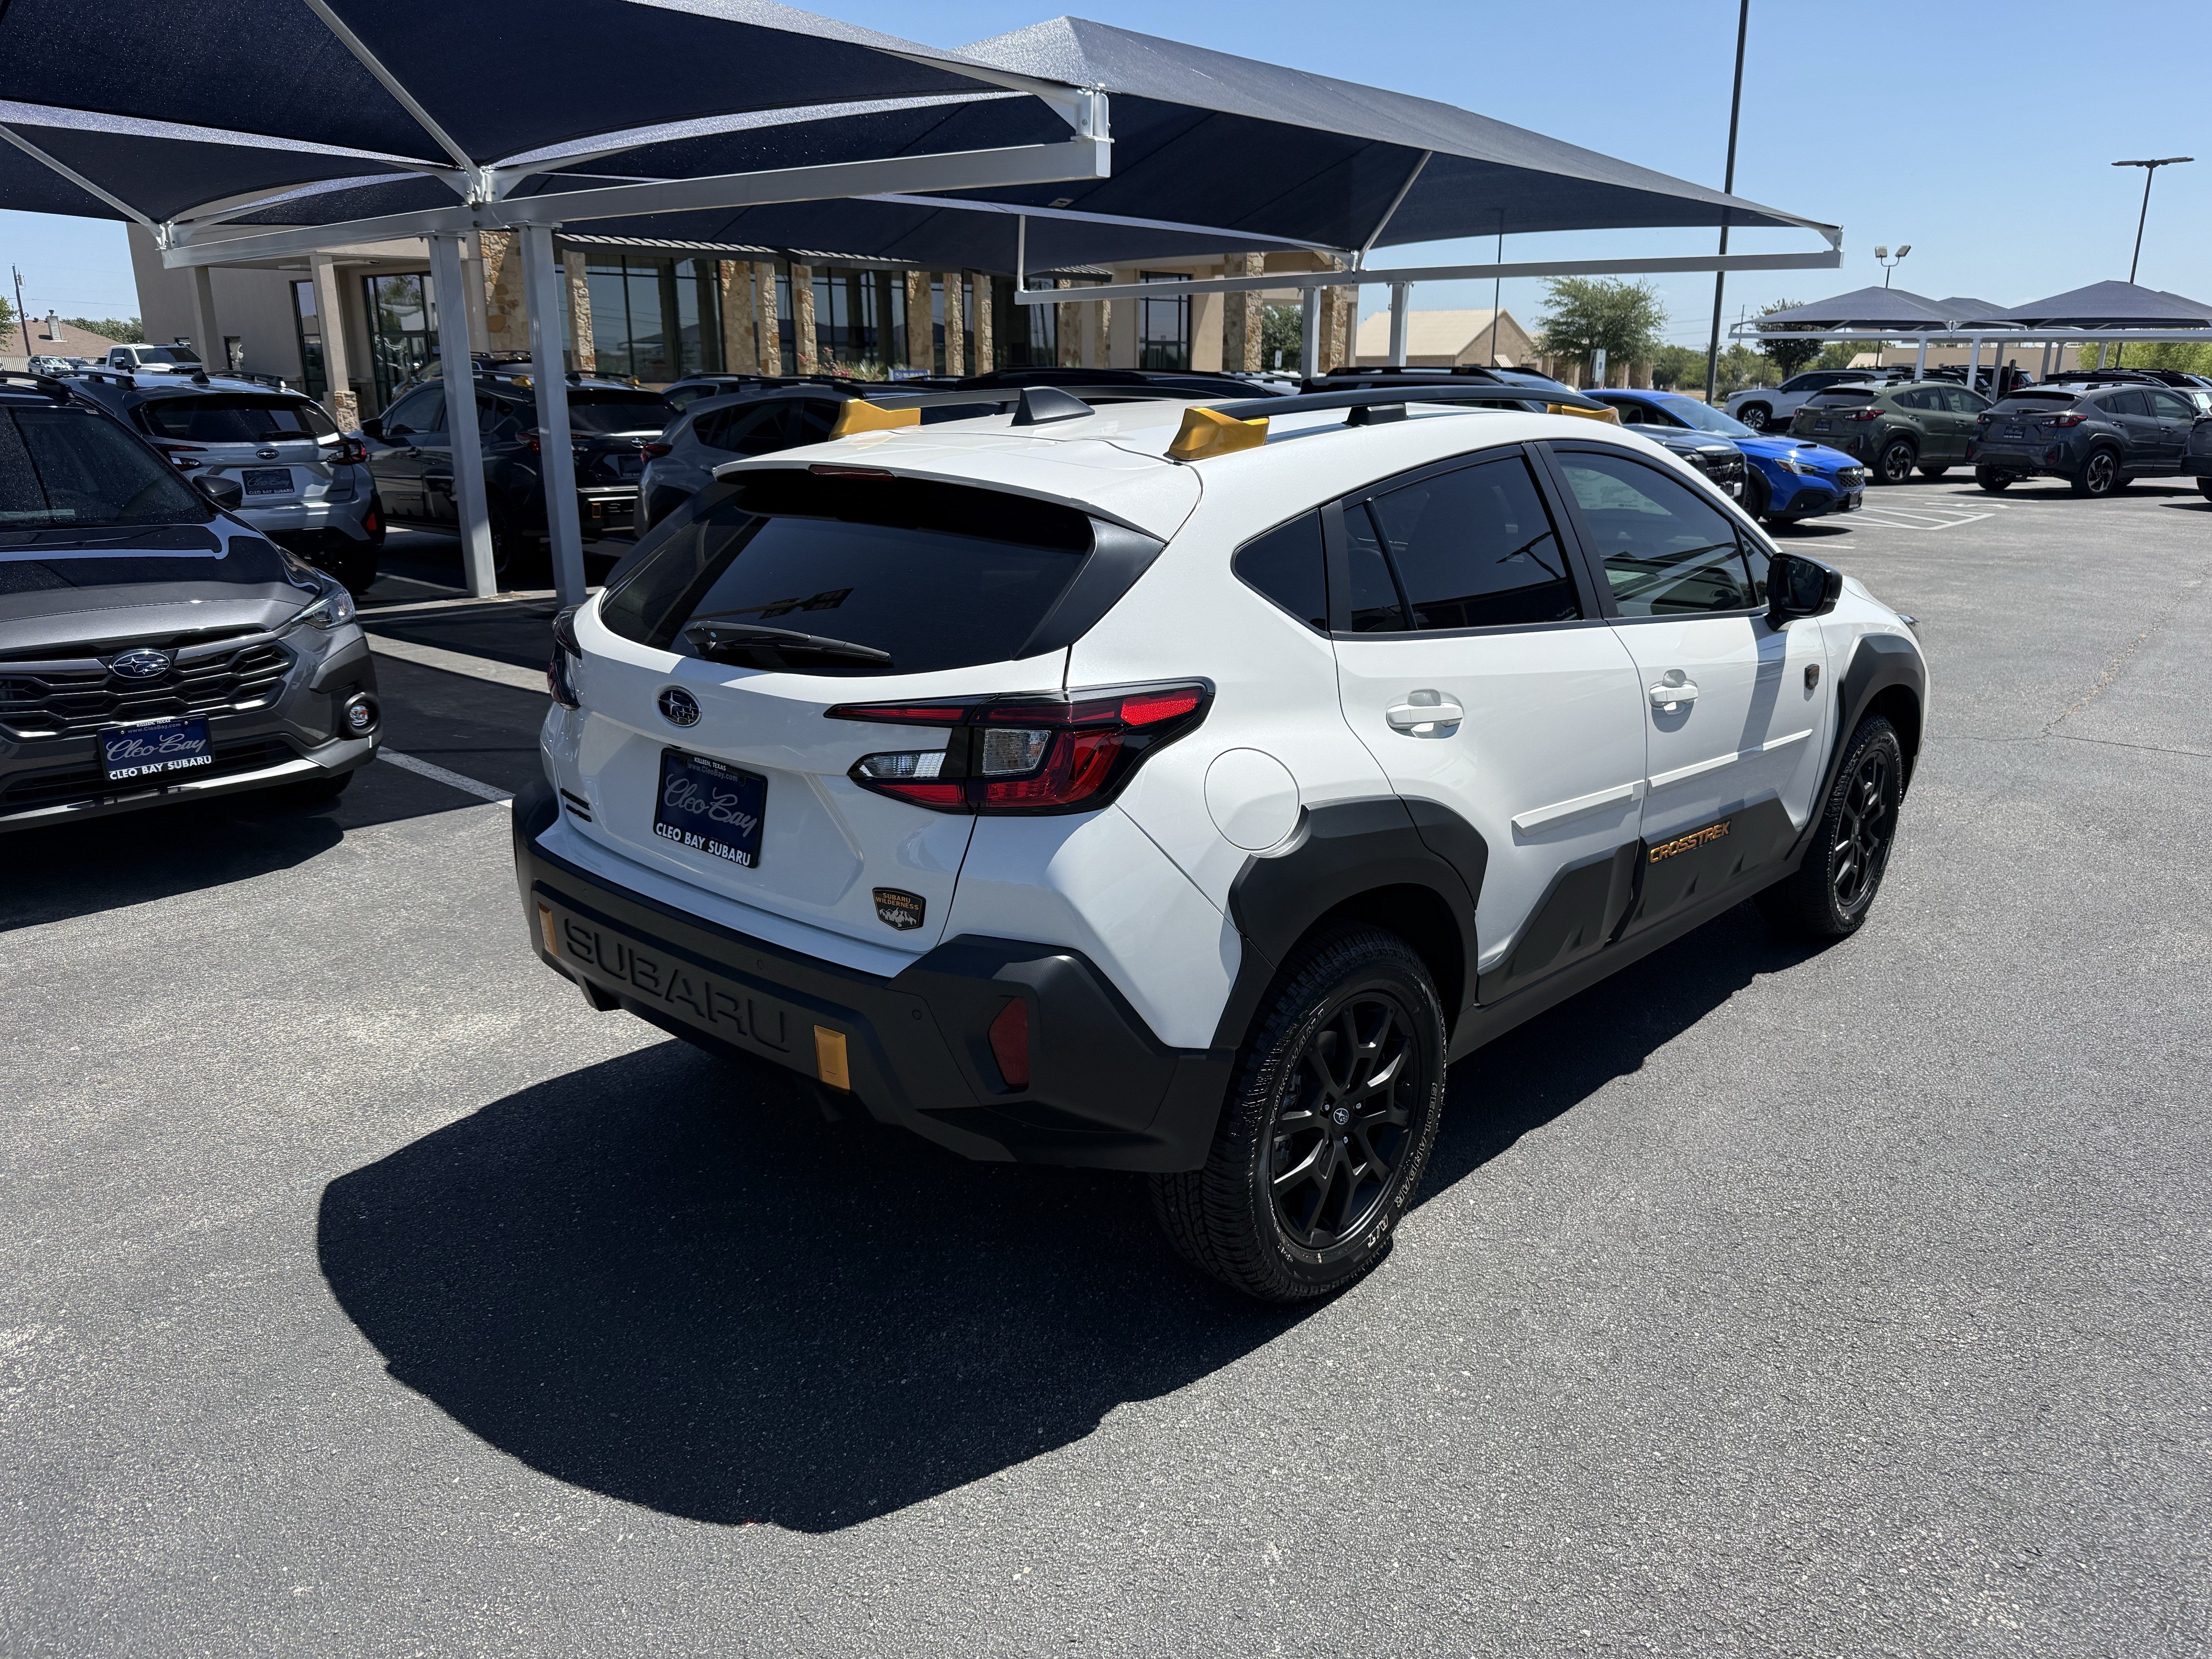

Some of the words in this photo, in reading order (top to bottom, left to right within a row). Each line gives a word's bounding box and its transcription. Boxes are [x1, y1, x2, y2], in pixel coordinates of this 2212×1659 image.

[127, 723, 181, 733] www.CleoBay.com
[106, 739, 159, 761] Cleo
[159, 733, 206, 753] Bay
[110, 768, 138, 780] CLEO
[142, 764, 164, 775] BAY
[168, 756, 212, 770] SUBARU
[687, 763, 738, 782] www.CleoBay.com
[694, 757, 712, 768] KILLEEN,
[712, 762, 726, 771] TEXAS
[664, 774, 709, 814] Cleo
[708, 787, 757, 838] Bay
[656, 823, 681, 842] CLEO
[684, 832, 706, 849] BAY
[708, 840, 751, 866] SUBARU
[1650, 821, 1731, 863] CROSSTREK
[876, 896, 919, 910] WILDERNESS
[883, 893, 911, 903] SUBARU
[564, 918, 790, 1053] SUBARU
[1395, 1083, 1437, 1208] GEOLANDAR
[1367, 1214, 1388, 1249] A/T
